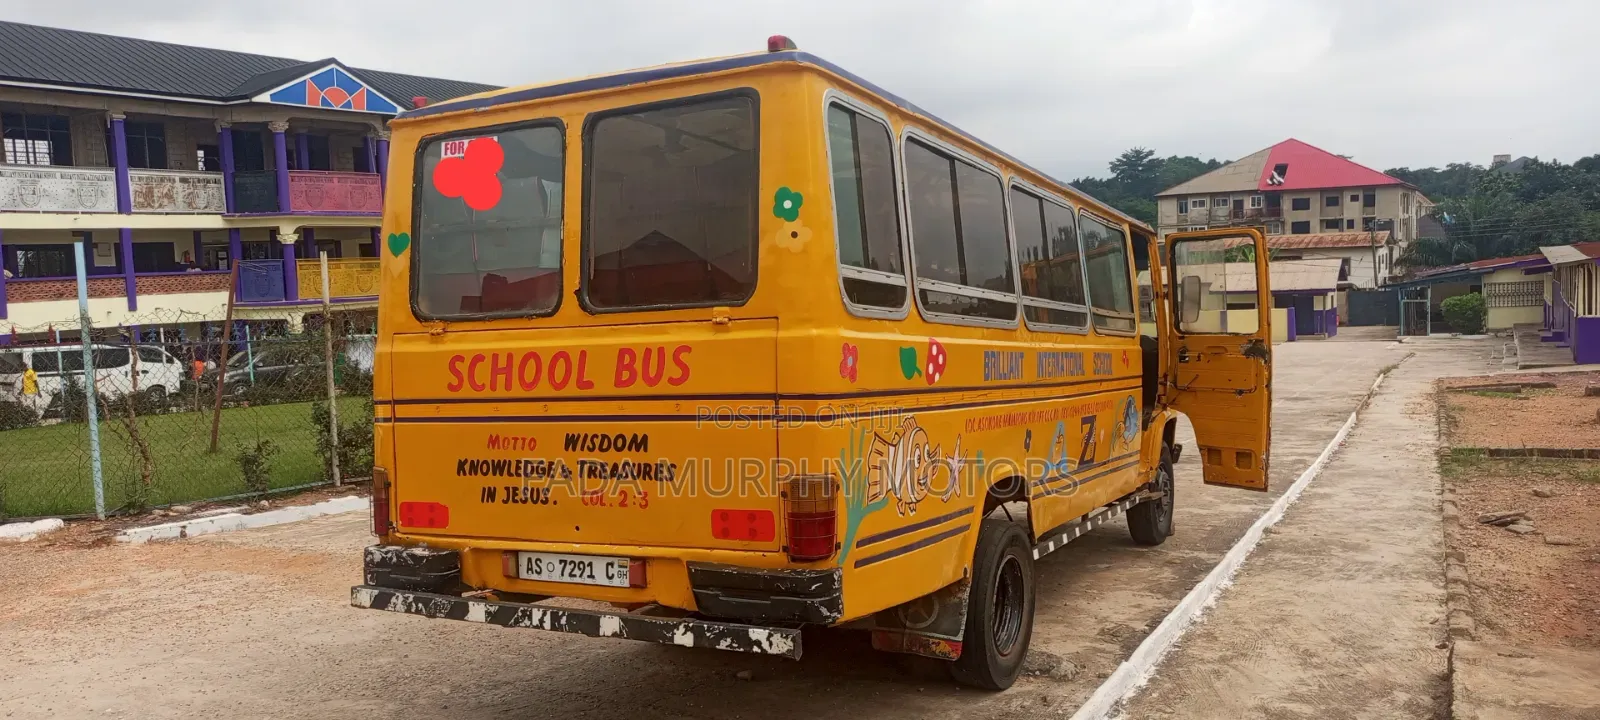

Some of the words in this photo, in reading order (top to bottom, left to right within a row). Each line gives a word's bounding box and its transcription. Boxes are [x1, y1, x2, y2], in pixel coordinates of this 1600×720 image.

[444, 141, 464, 156] FOR
[447, 349, 594, 392] SCHOOL
[614, 345, 692, 388] BUS
[984, 351, 1024, 381] BRILLIANT
[1036, 352, 1085, 378] INTERNATIONAL
[1093, 352, 1112, 375] SCHOOL
[487, 433, 537, 451] MOTTO
[564, 433, 648, 453] WISDOM
[457, 458, 554, 479] KNOWLEDGE
[577, 459, 677, 482] TREASURES
[481, 487, 496, 503] IN
[526, 557, 542, 575] AS
[559, 559, 596, 580] 7291
[605, 562, 614, 580] C
[617, 570, 628, 580] GH
